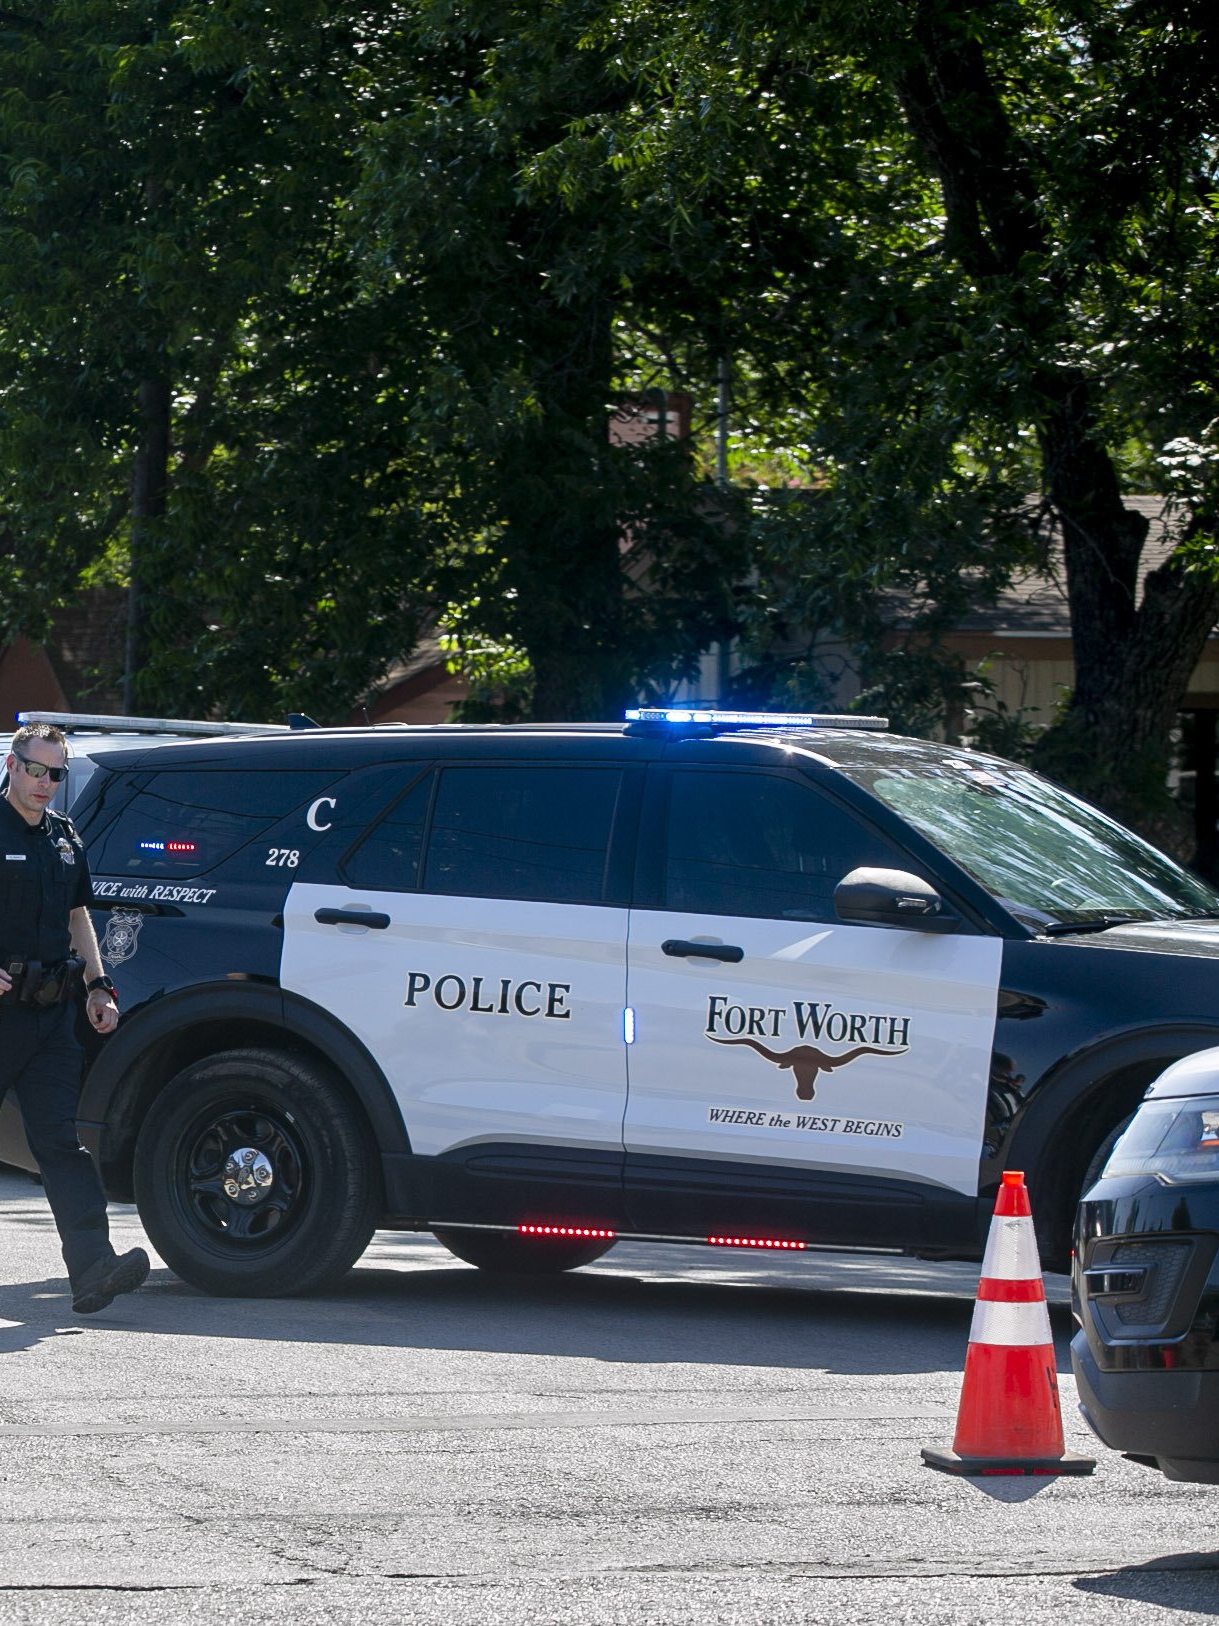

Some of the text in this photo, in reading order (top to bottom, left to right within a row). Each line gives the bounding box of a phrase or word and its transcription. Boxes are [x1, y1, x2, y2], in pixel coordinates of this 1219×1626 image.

[306, 797, 337, 832] C
[265, 848, 300, 868] 278
[120, 885, 148, 899] with
[148, 886, 216, 904] RESPECT
[404, 972, 571, 1019] POLICE
[706, 996, 911, 1046] FORT WORTH
[709, 1108, 902, 1138] WHERE the WEST BEGINS
